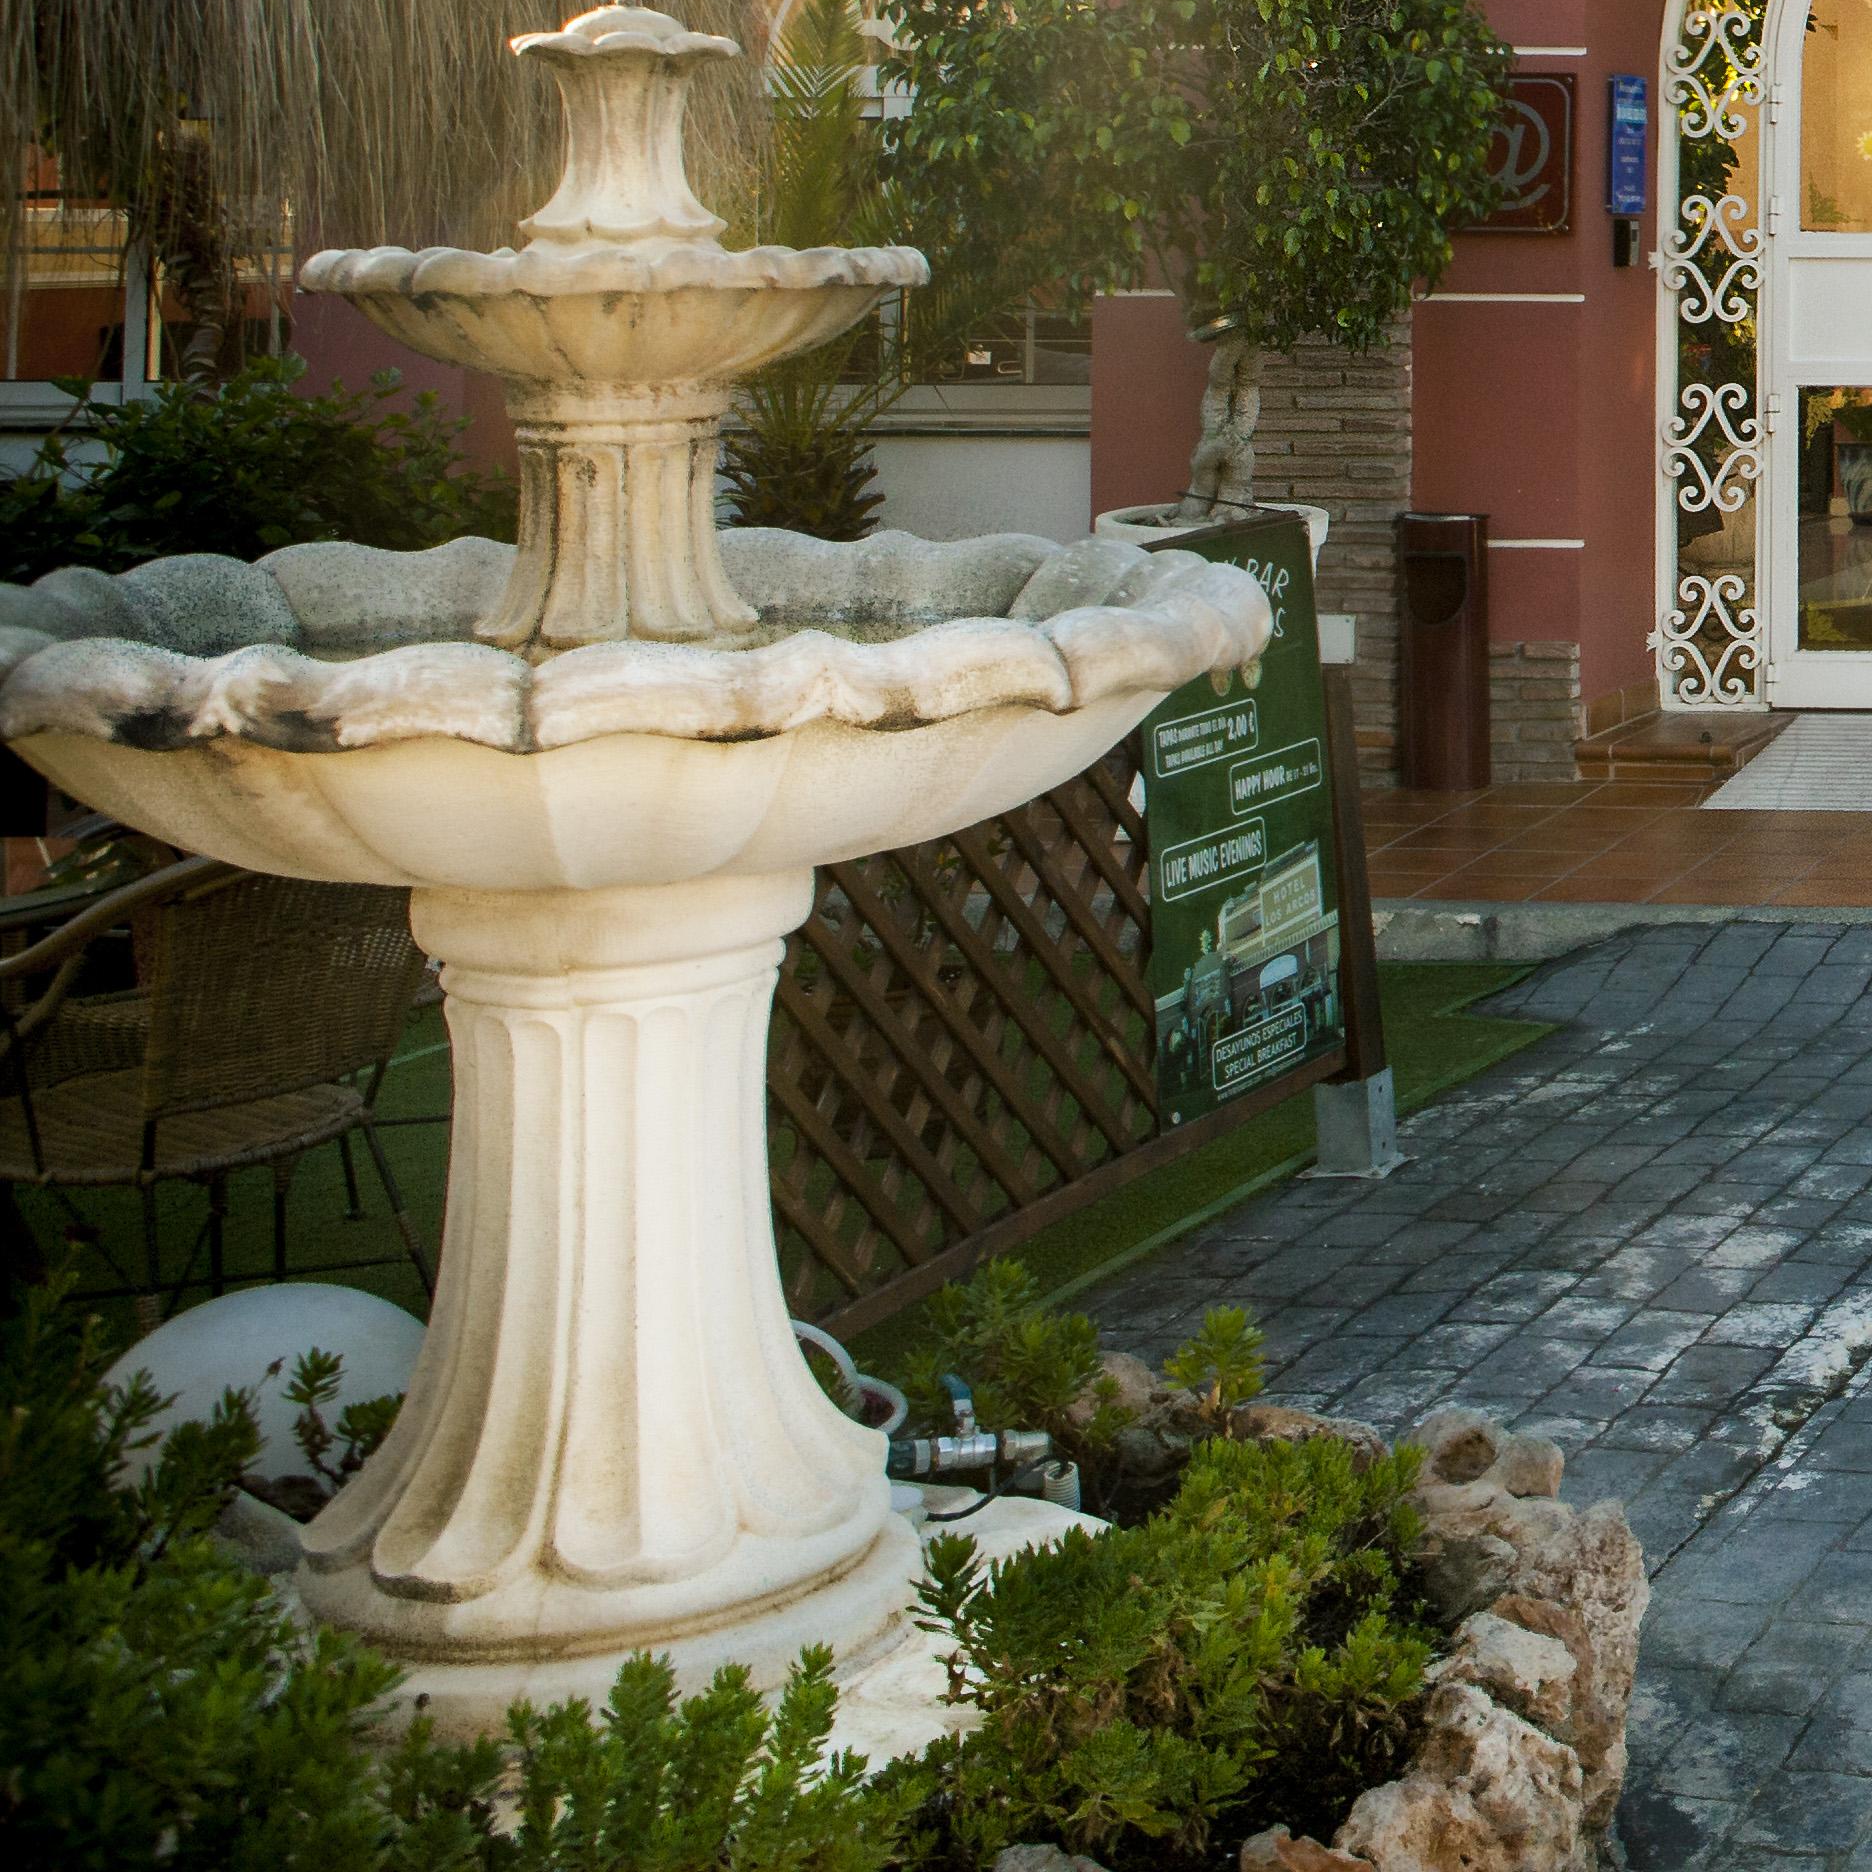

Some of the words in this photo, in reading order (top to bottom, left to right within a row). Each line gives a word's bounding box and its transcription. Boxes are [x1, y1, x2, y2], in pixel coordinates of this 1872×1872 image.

[1247, 558, 1290, 599] BAR
[1227, 714, 1248, 741] 2,00
[1235, 772, 1261, 801] HAPPY
[1263, 765, 1286, 791] HOUR
[1165, 856, 1187, 888] LIVE
[1188, 846, 1219, 881] MUSIC
[1220, 830, 1263, 869] EVENINGS
[1273, 878, 1305, 904] HOTEL
[1216, 1030, 1261, 1063] DESAYUNOS
[1262, 1011, 1303, 1042] ESPECIALES
[1225, 1054, 1257, 1079] SPECIAL
[1257, 1032, 1297, 1063] BREAKFAST
